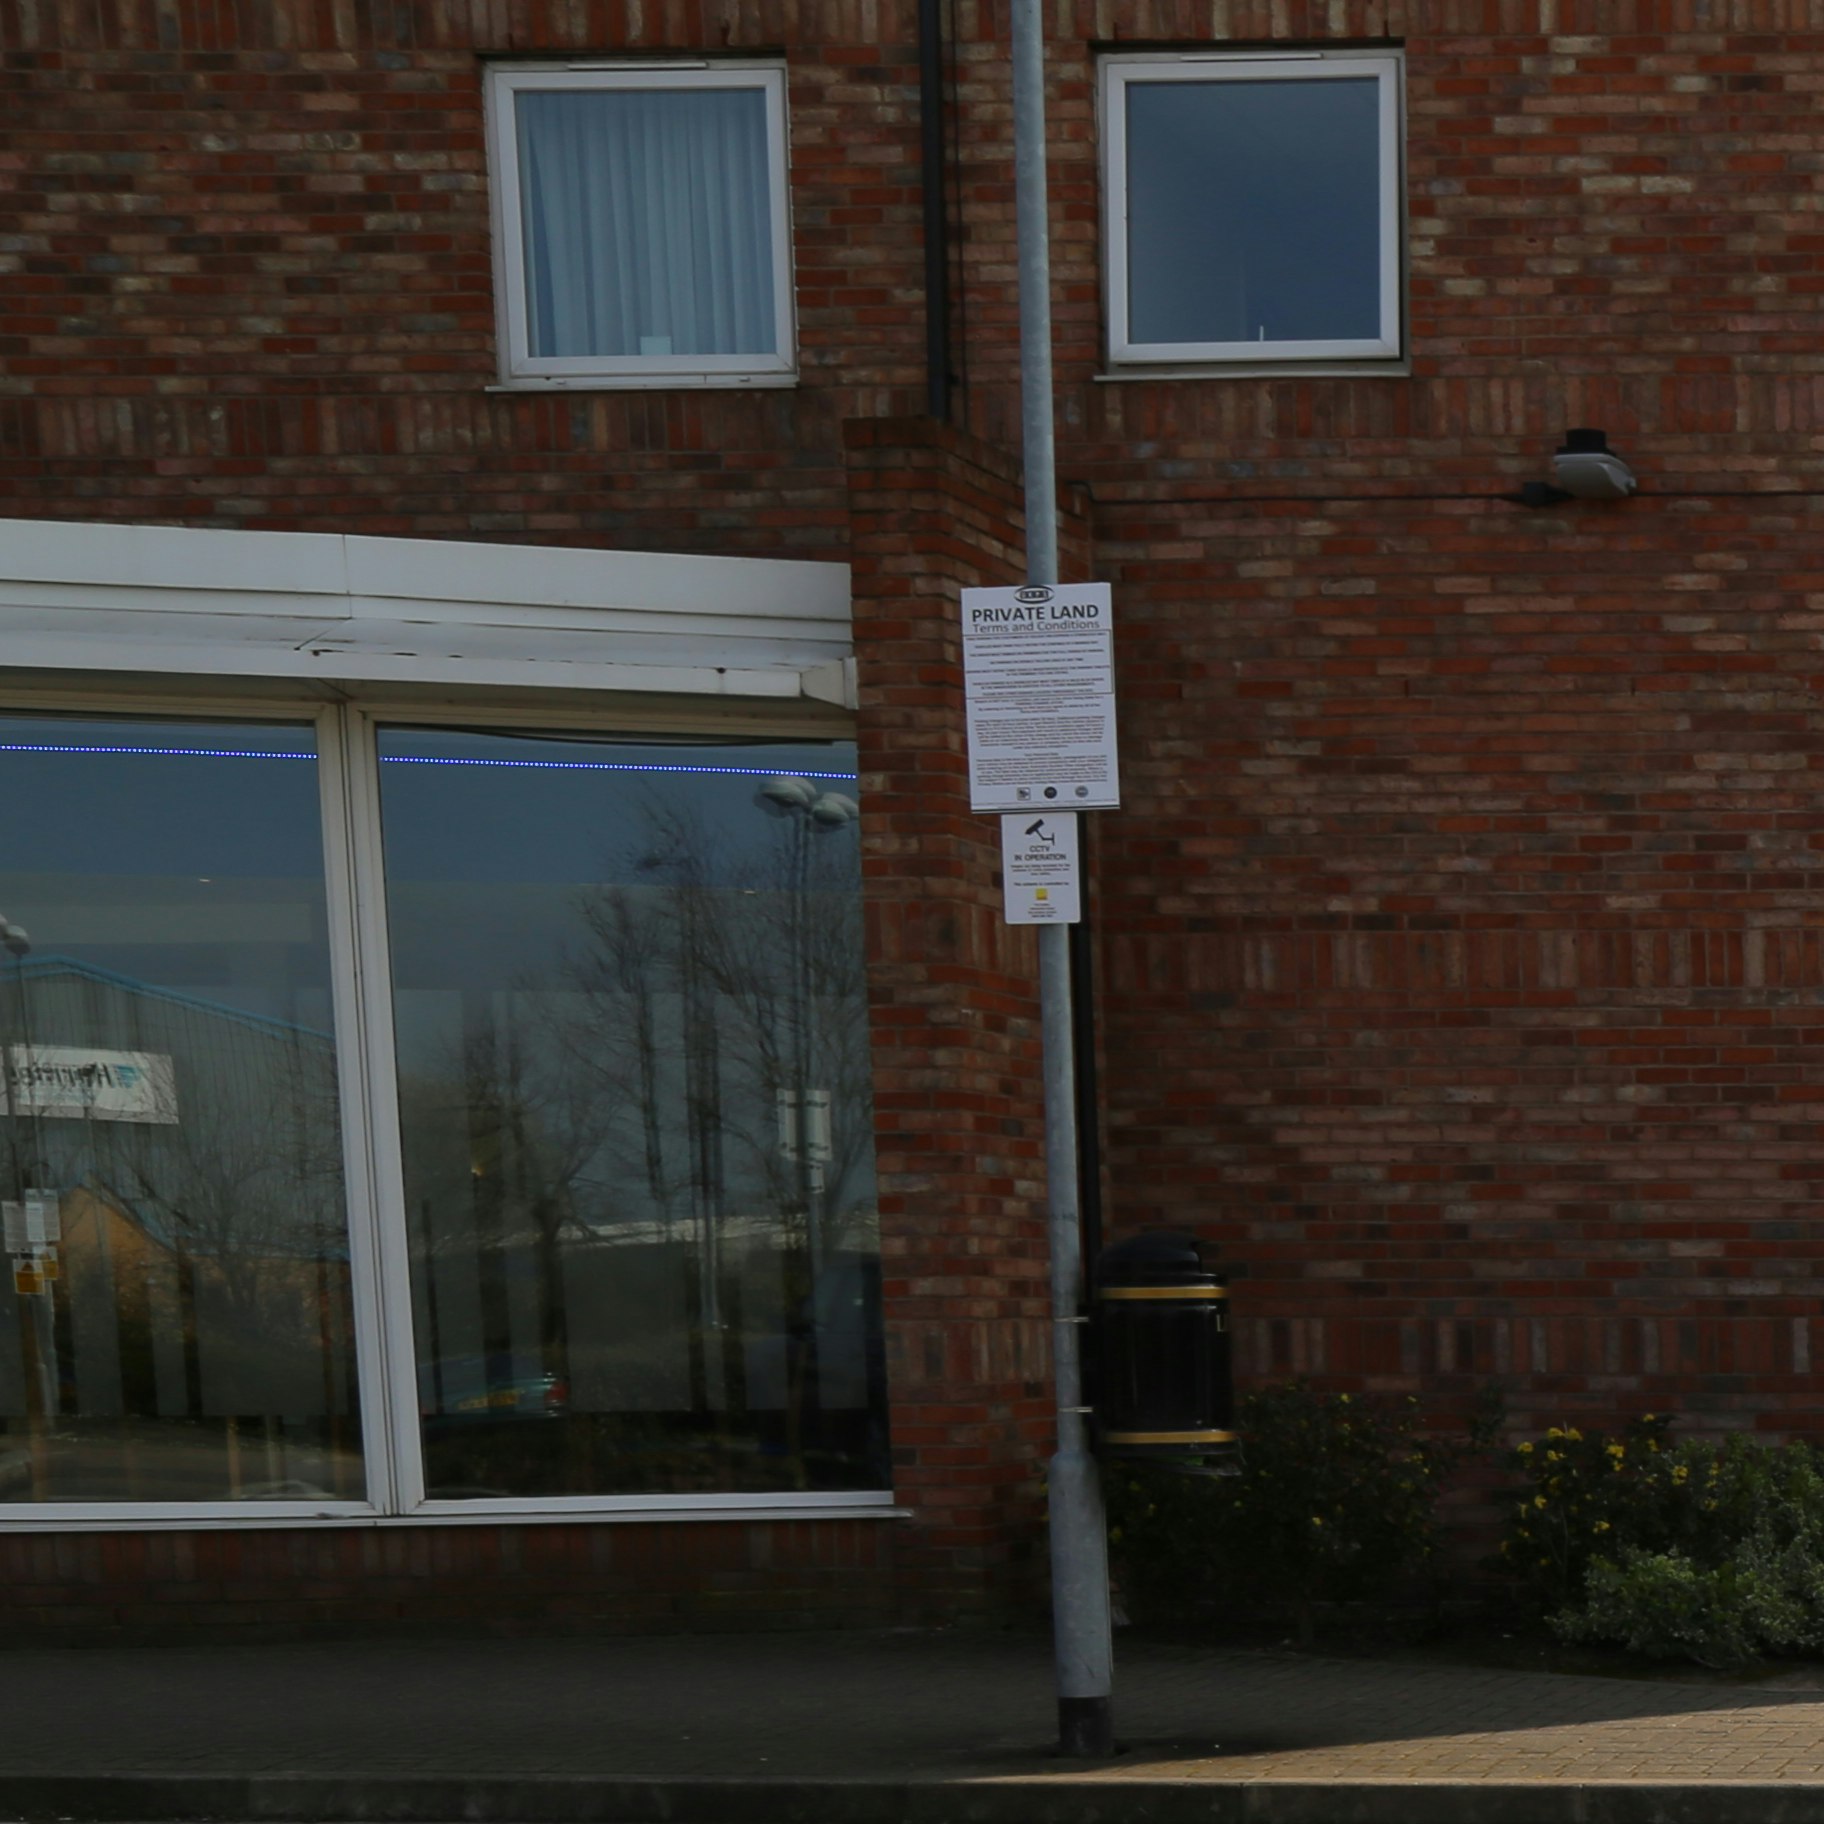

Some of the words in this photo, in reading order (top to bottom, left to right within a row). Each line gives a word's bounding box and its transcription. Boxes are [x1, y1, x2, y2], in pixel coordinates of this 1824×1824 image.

[972, 606, 1045, 622] PRIVATE
[1051, 604, 1099, 620] LAND
[973, 622, 1009, 633] Terms
[1012, 621, 1034, 632] and
[1037, 620, 1100, 631] Conditions
